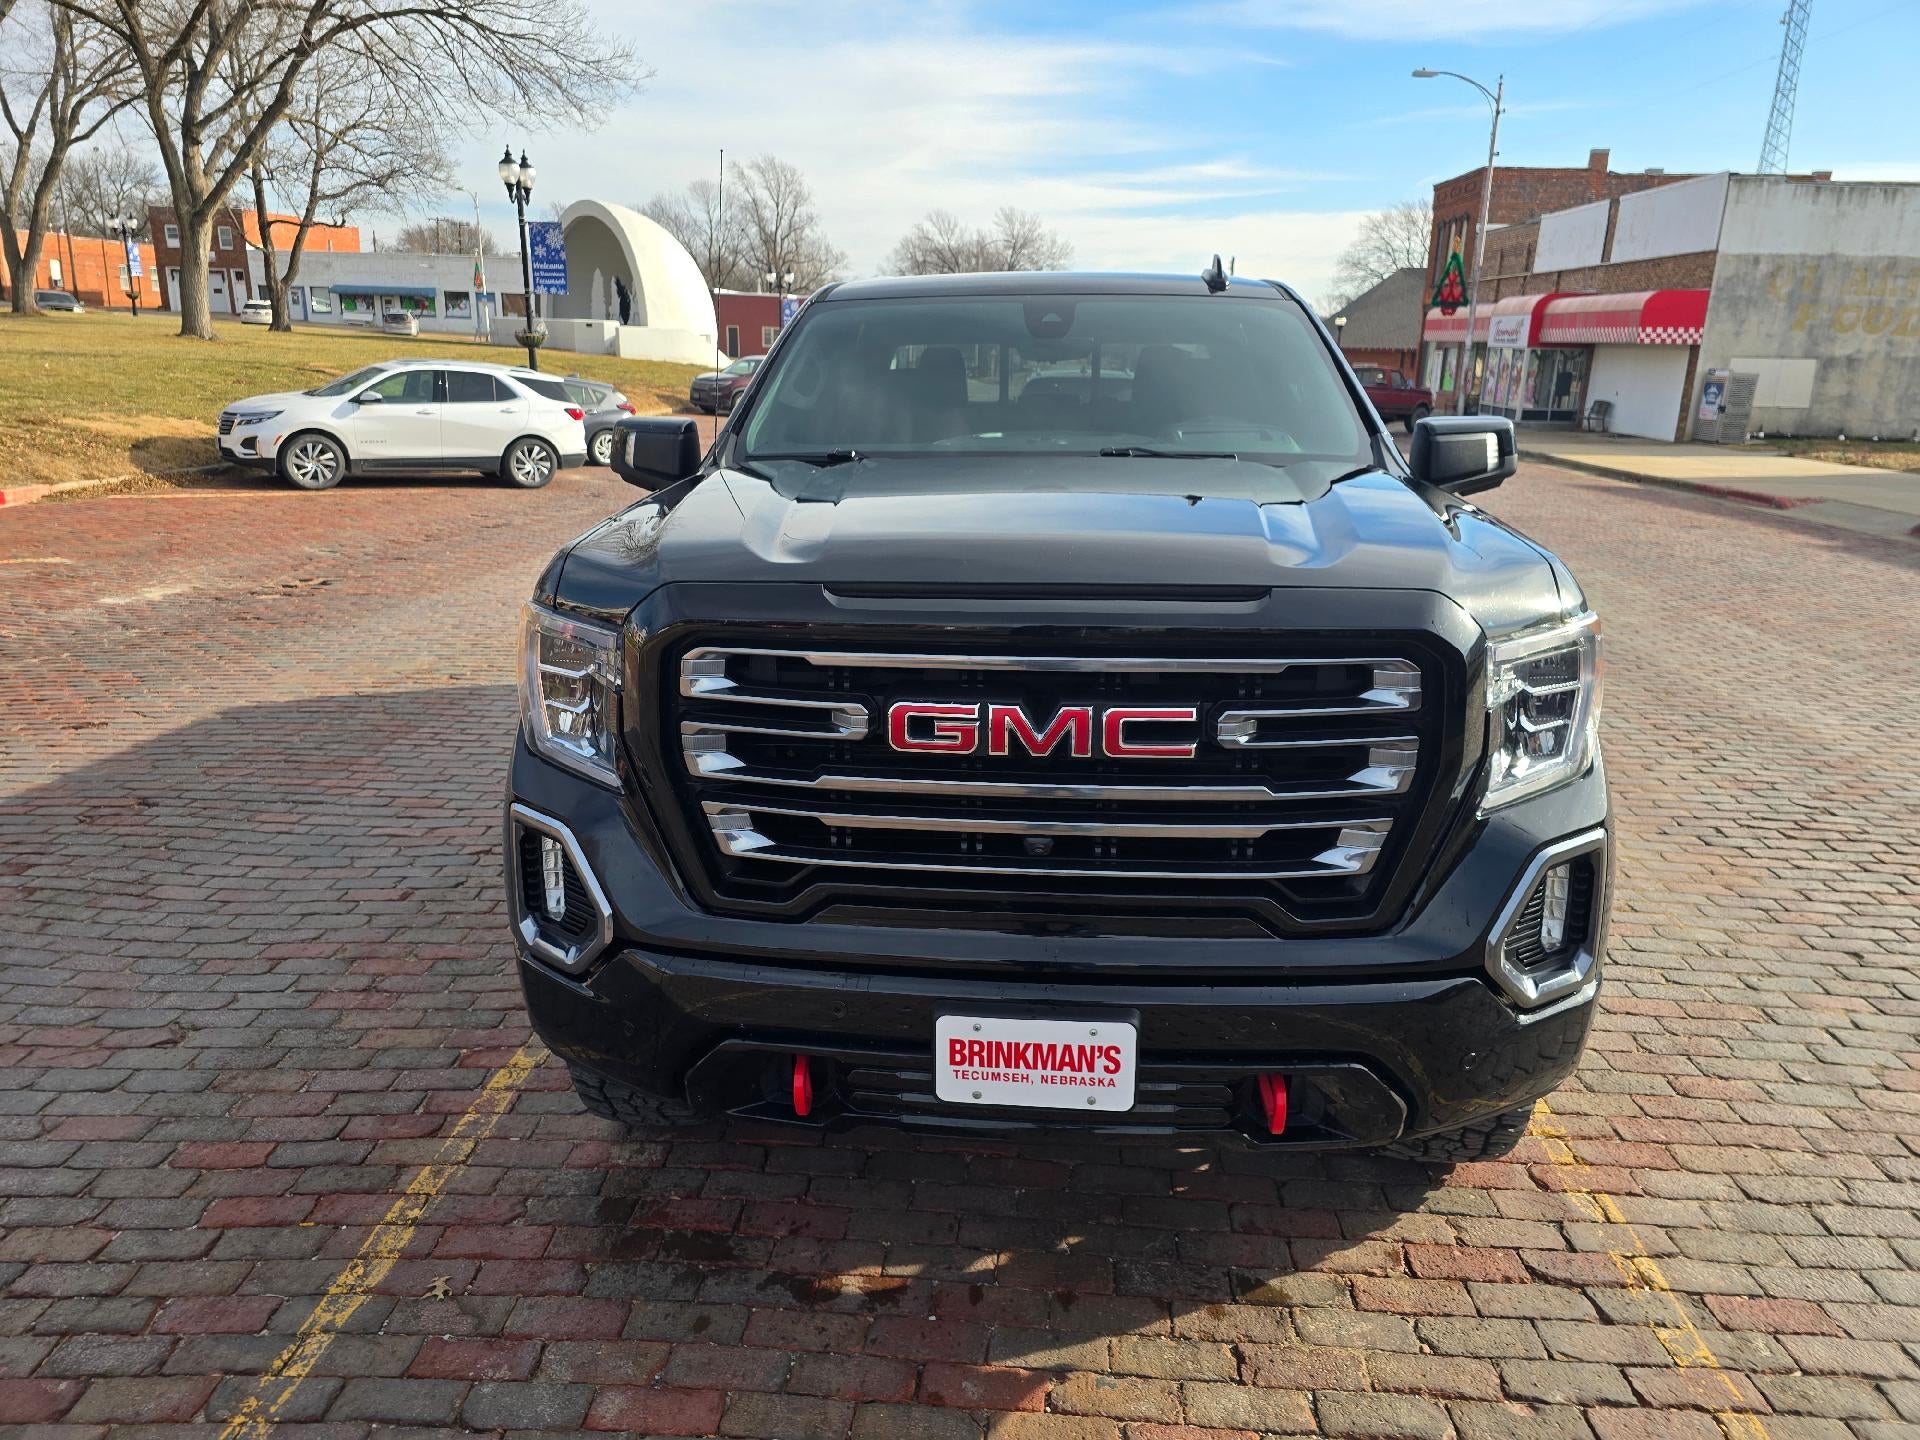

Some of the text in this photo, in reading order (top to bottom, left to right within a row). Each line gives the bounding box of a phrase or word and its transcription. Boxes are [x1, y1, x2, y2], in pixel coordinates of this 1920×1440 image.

[533, 261, 564, 270] Welcome
[888, 702, 1198, 758] GMC
[949, 1038, 1121, 1075] BRINKMAN'S
[953, 1069, 1117, 1088] TECUMSEH, NEBRASKA
